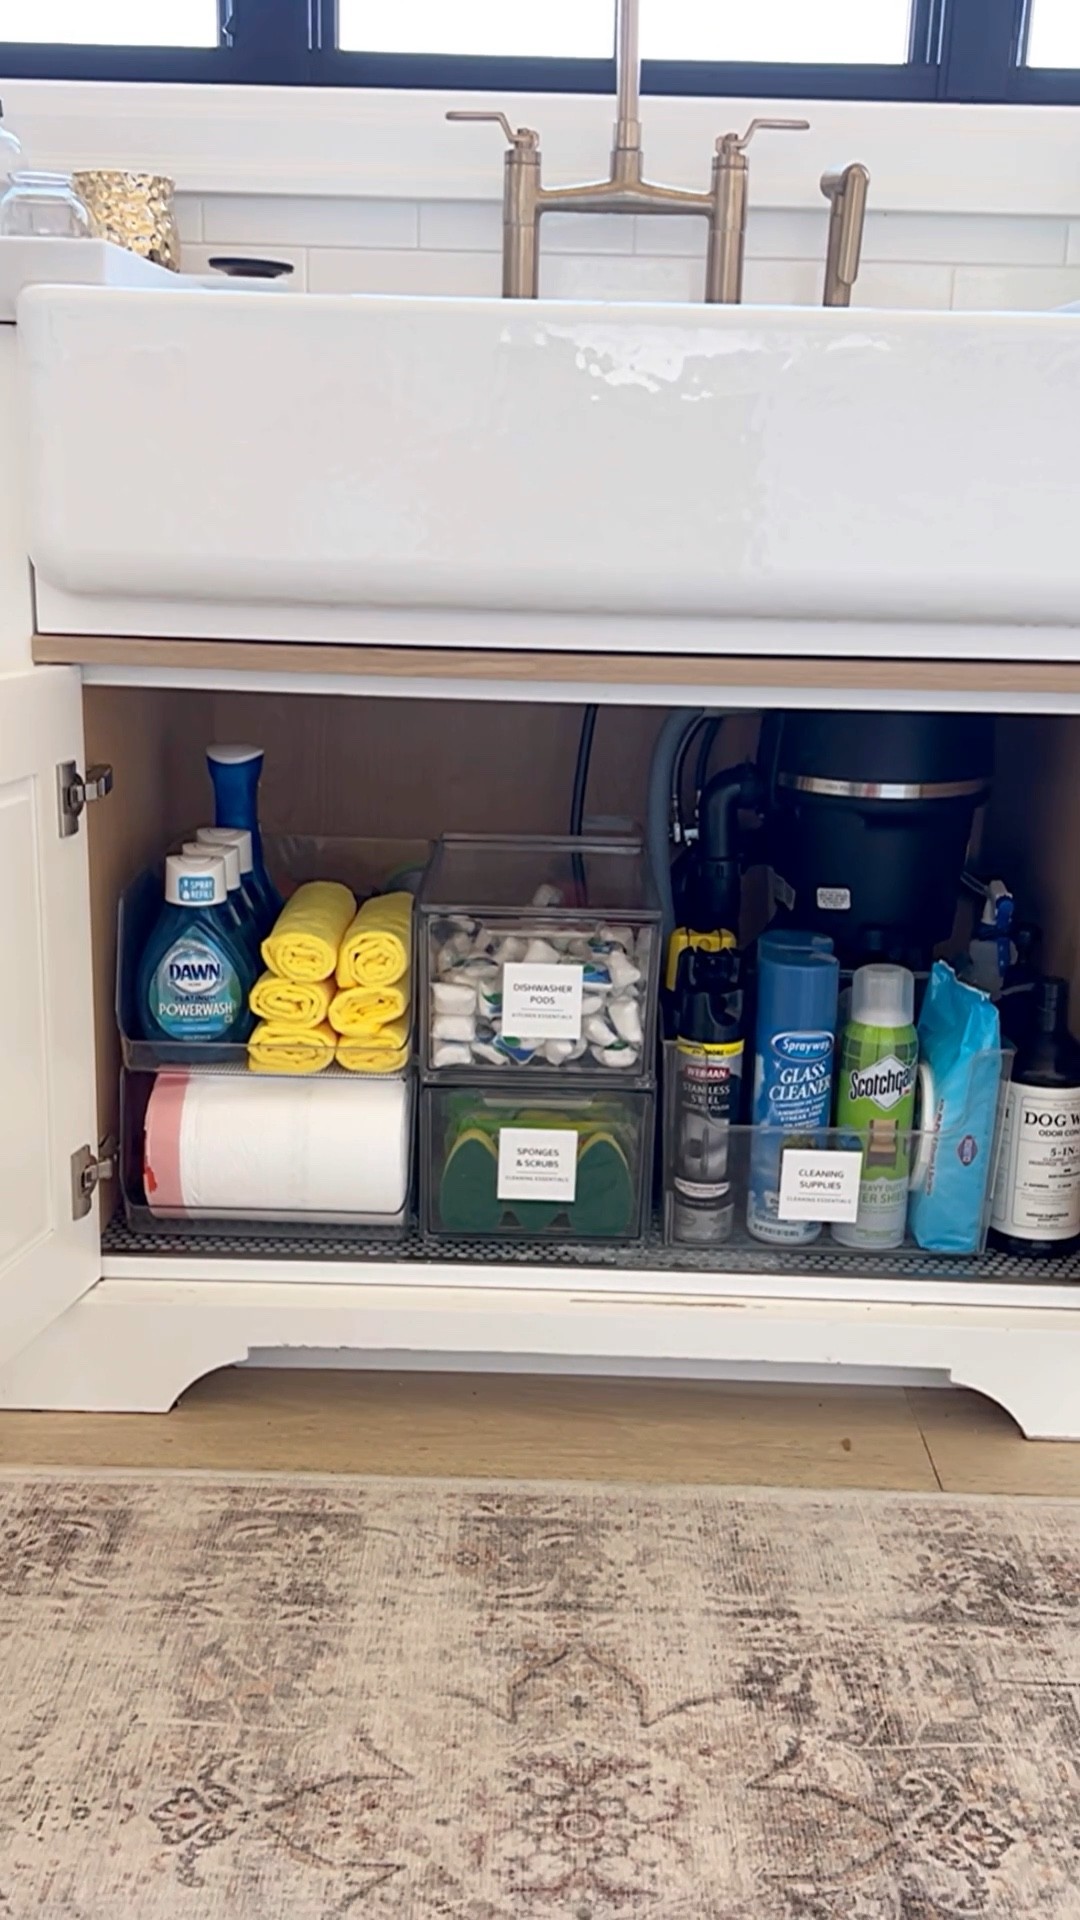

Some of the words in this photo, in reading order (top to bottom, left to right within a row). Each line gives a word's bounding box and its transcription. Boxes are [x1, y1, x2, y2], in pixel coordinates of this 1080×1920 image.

[190, 880, 213, 890] SPRAY
[190, 891, 213, 899] REFILL
[169, 963, 221, 981] DAWN
[513, 983, 573, 993] DISHWASHER
[530, 996, 556, 1005] PODS
[159, 1002, 233, 1016] POWERWASH
[782, 1037, 830, 1055] Sprayway
[780, 1061, 827, 1085] GLASS
[1024, 1110, 1067, 1128] DOG
[1038, 1129, 1063, 1137] ODOR
[517, 1147, 560, 1157] SPONGES
[516, 1159, 523, 1167] &
[524, 1159, 559, 1168] SCRUBS
[798, 1169, 845, 1179] CLEANING
[799, 1181, 842, 1190] SUPPLIES
